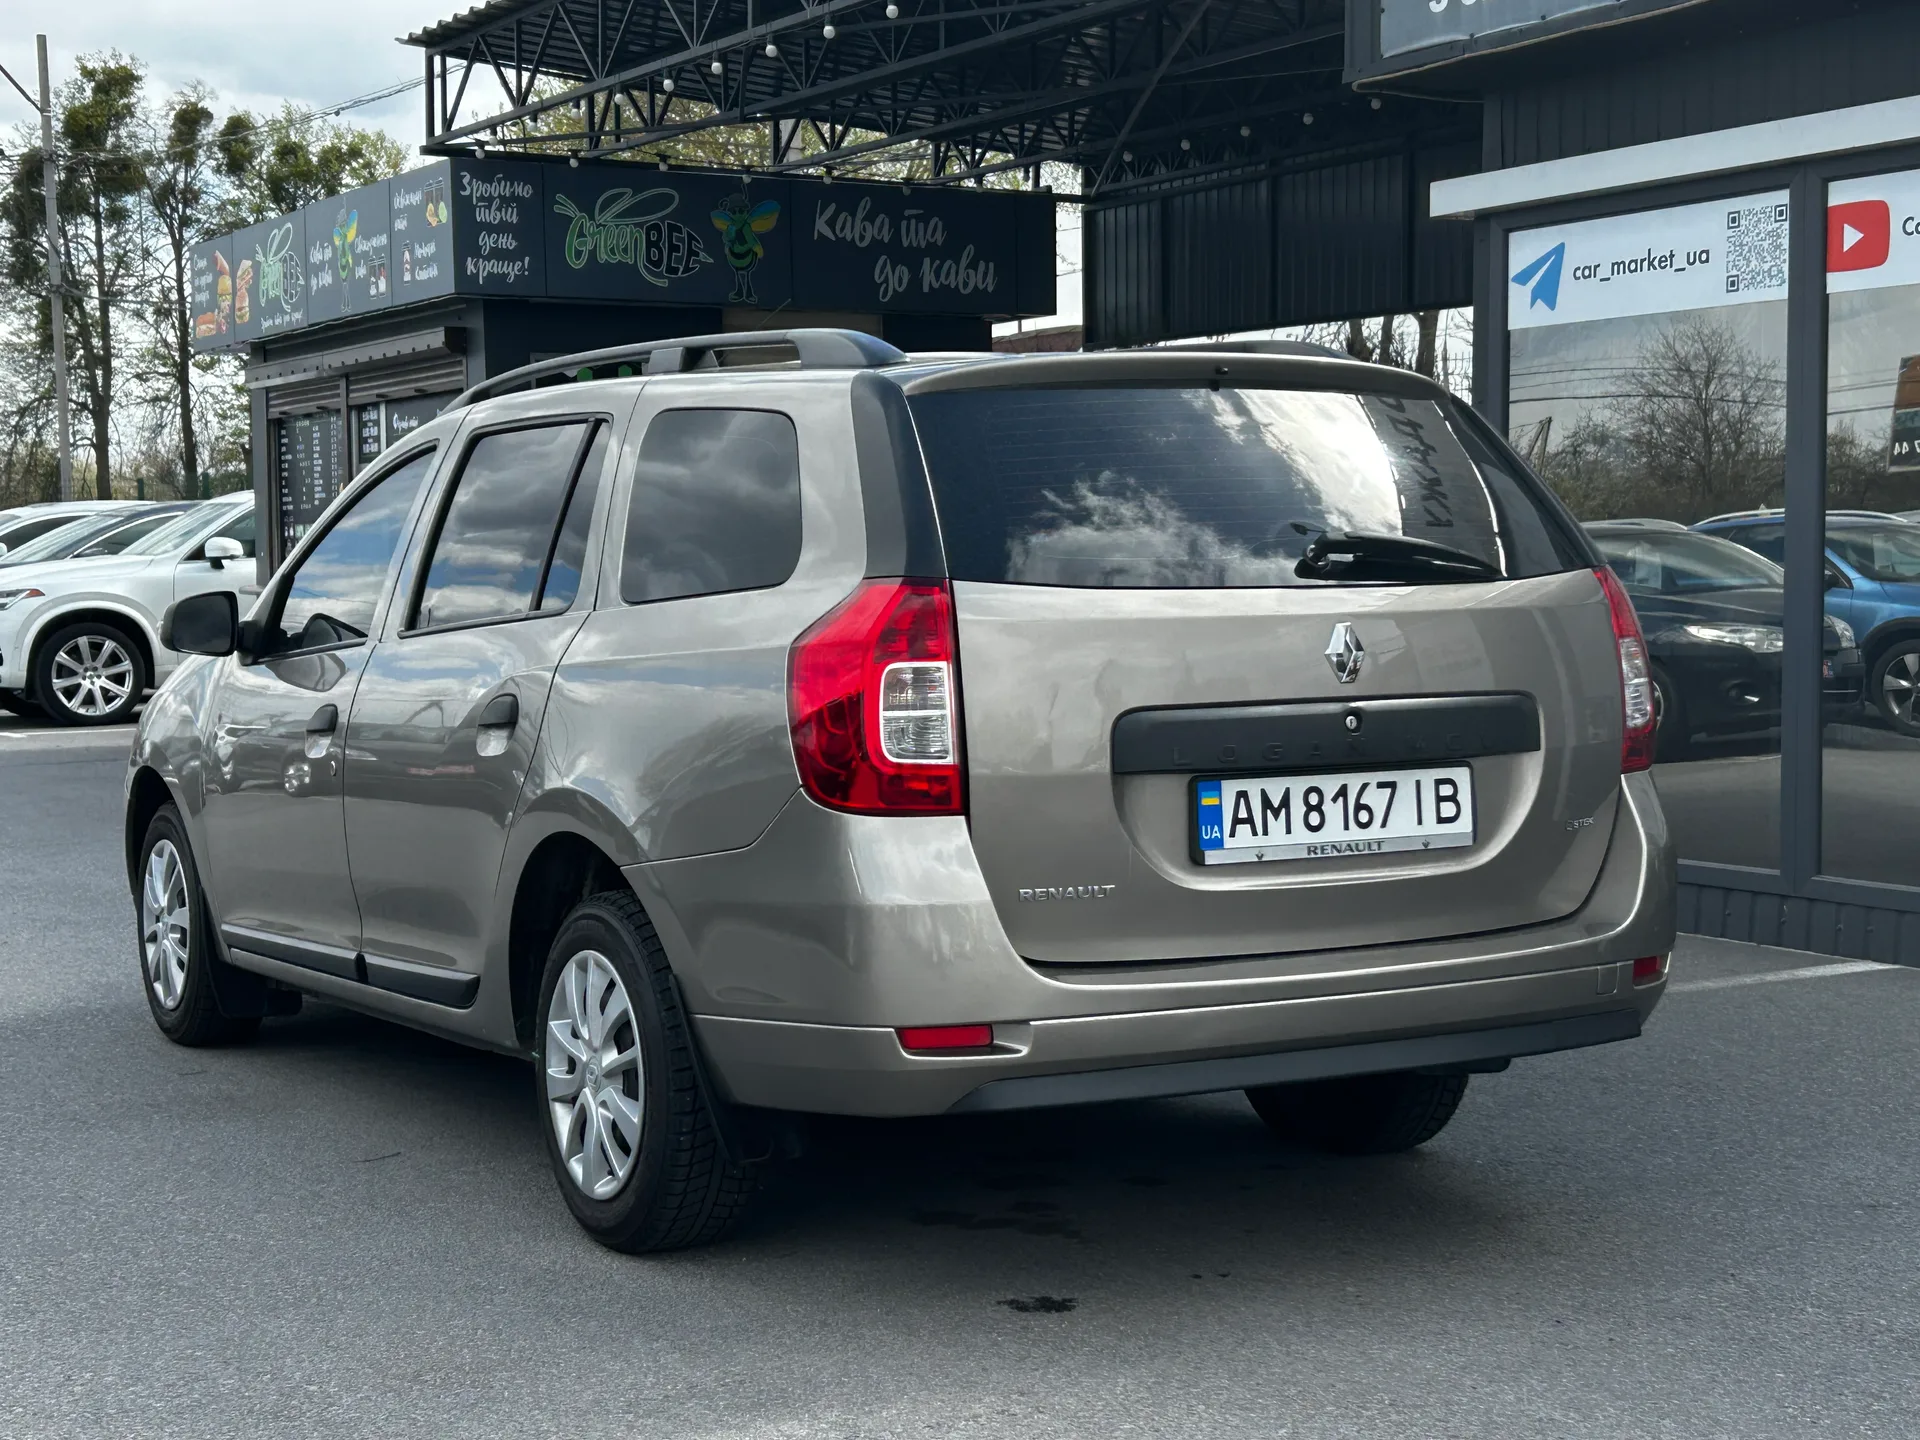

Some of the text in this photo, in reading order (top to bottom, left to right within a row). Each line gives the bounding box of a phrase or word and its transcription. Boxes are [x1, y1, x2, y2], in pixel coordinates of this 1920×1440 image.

[459, 171, 533, 205] Зробимо
[475, 199, 519, 224] твій
[814, 196, 947, 248] Кава та
[478, 230, 518, 255] день
[465, 256, 530, 284] краще!
[874, 244, 998, 302] до кави
[1573, 248, 1710, 282] car_market_ua
[1202, 825, 1220, 839] UA
[1307, 841, 1385, 857] RENAULT
[1019, 885, 1116, 902] RENAULT
